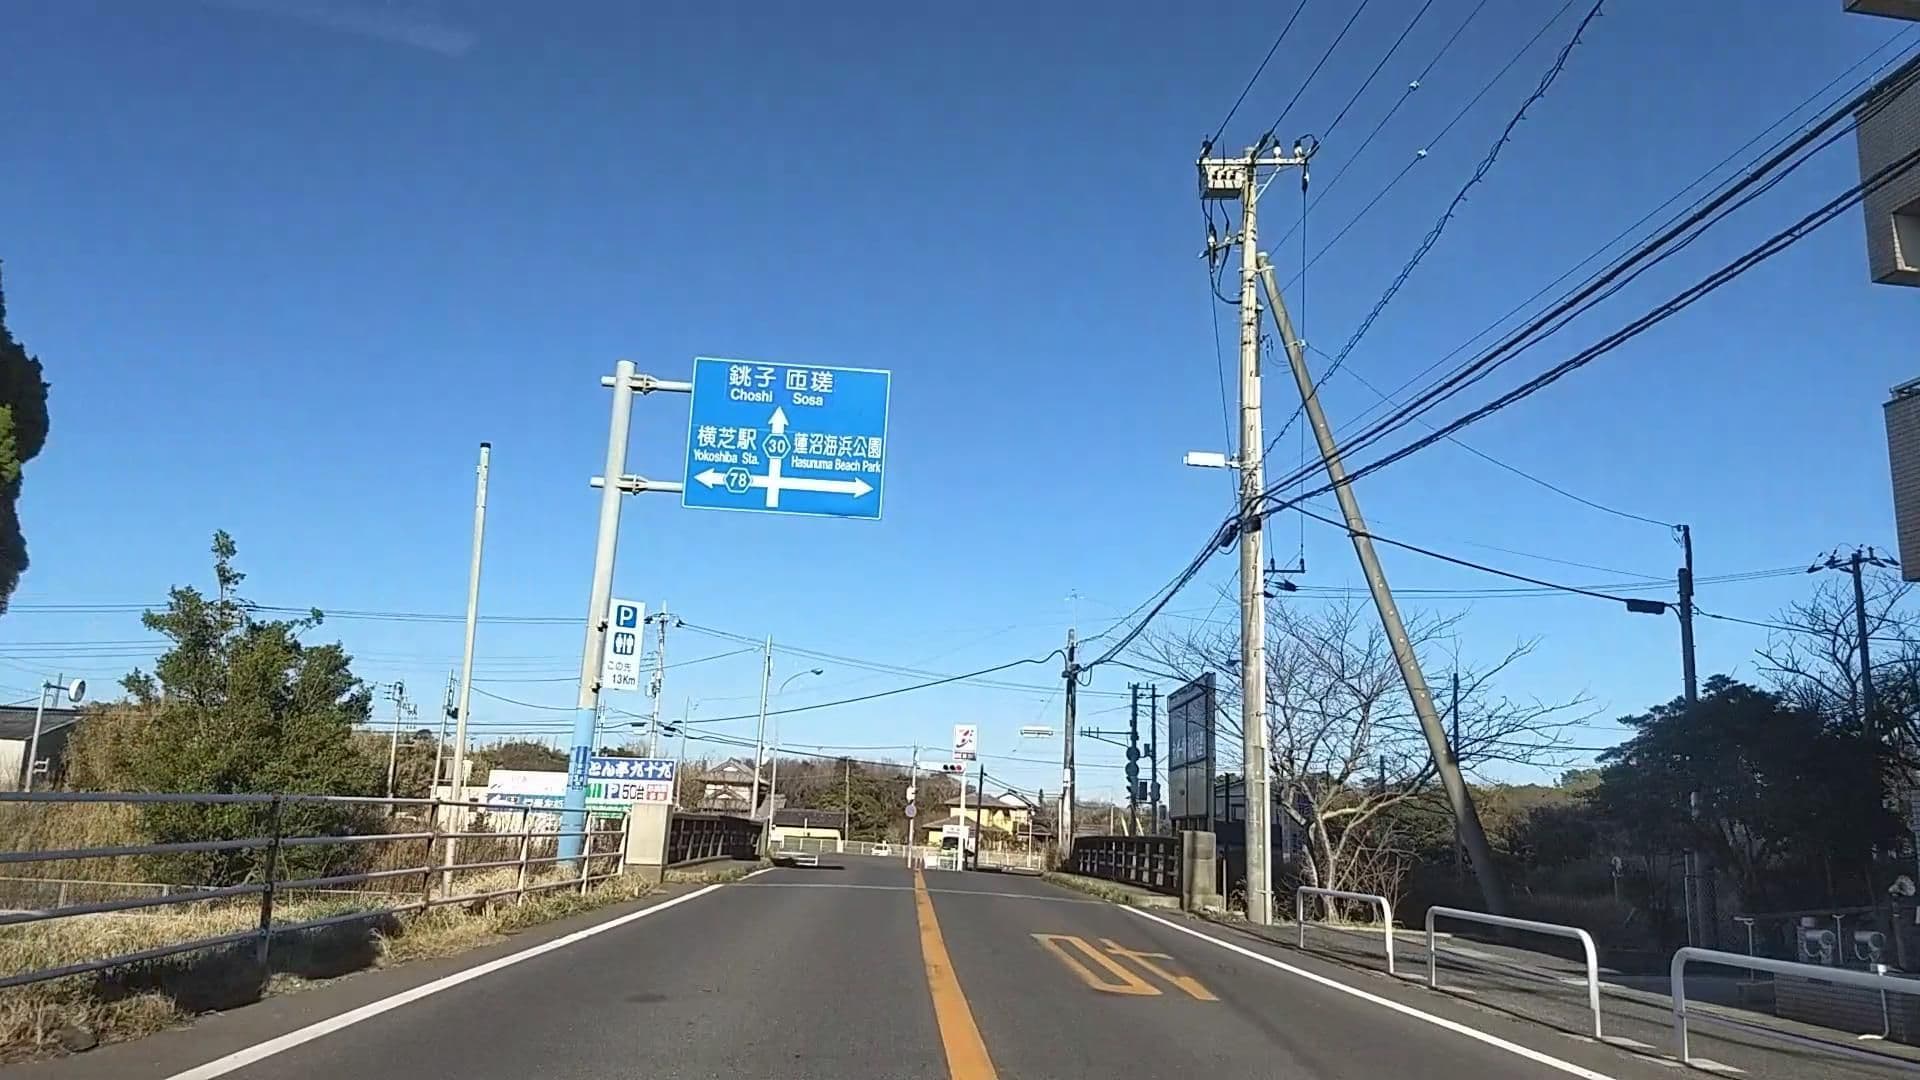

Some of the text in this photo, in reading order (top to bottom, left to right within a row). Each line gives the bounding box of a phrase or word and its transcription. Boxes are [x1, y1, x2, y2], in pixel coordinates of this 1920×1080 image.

[729, 364, 833, 393] 銚子 匝瑳
[730, 388, 823, 406] Choshi Sosa
[697, 425, 757, 451] 横芝駅
[793, 431, 882, 459] 蓮沼海浜公園
[768, 440, 786, 454] 30
[693, 448, 759, 465] Yokoshiba Sta.
[791, 456, 881, 473] Hasunuma Beach Park
[729, 473, 747, 487] 78
